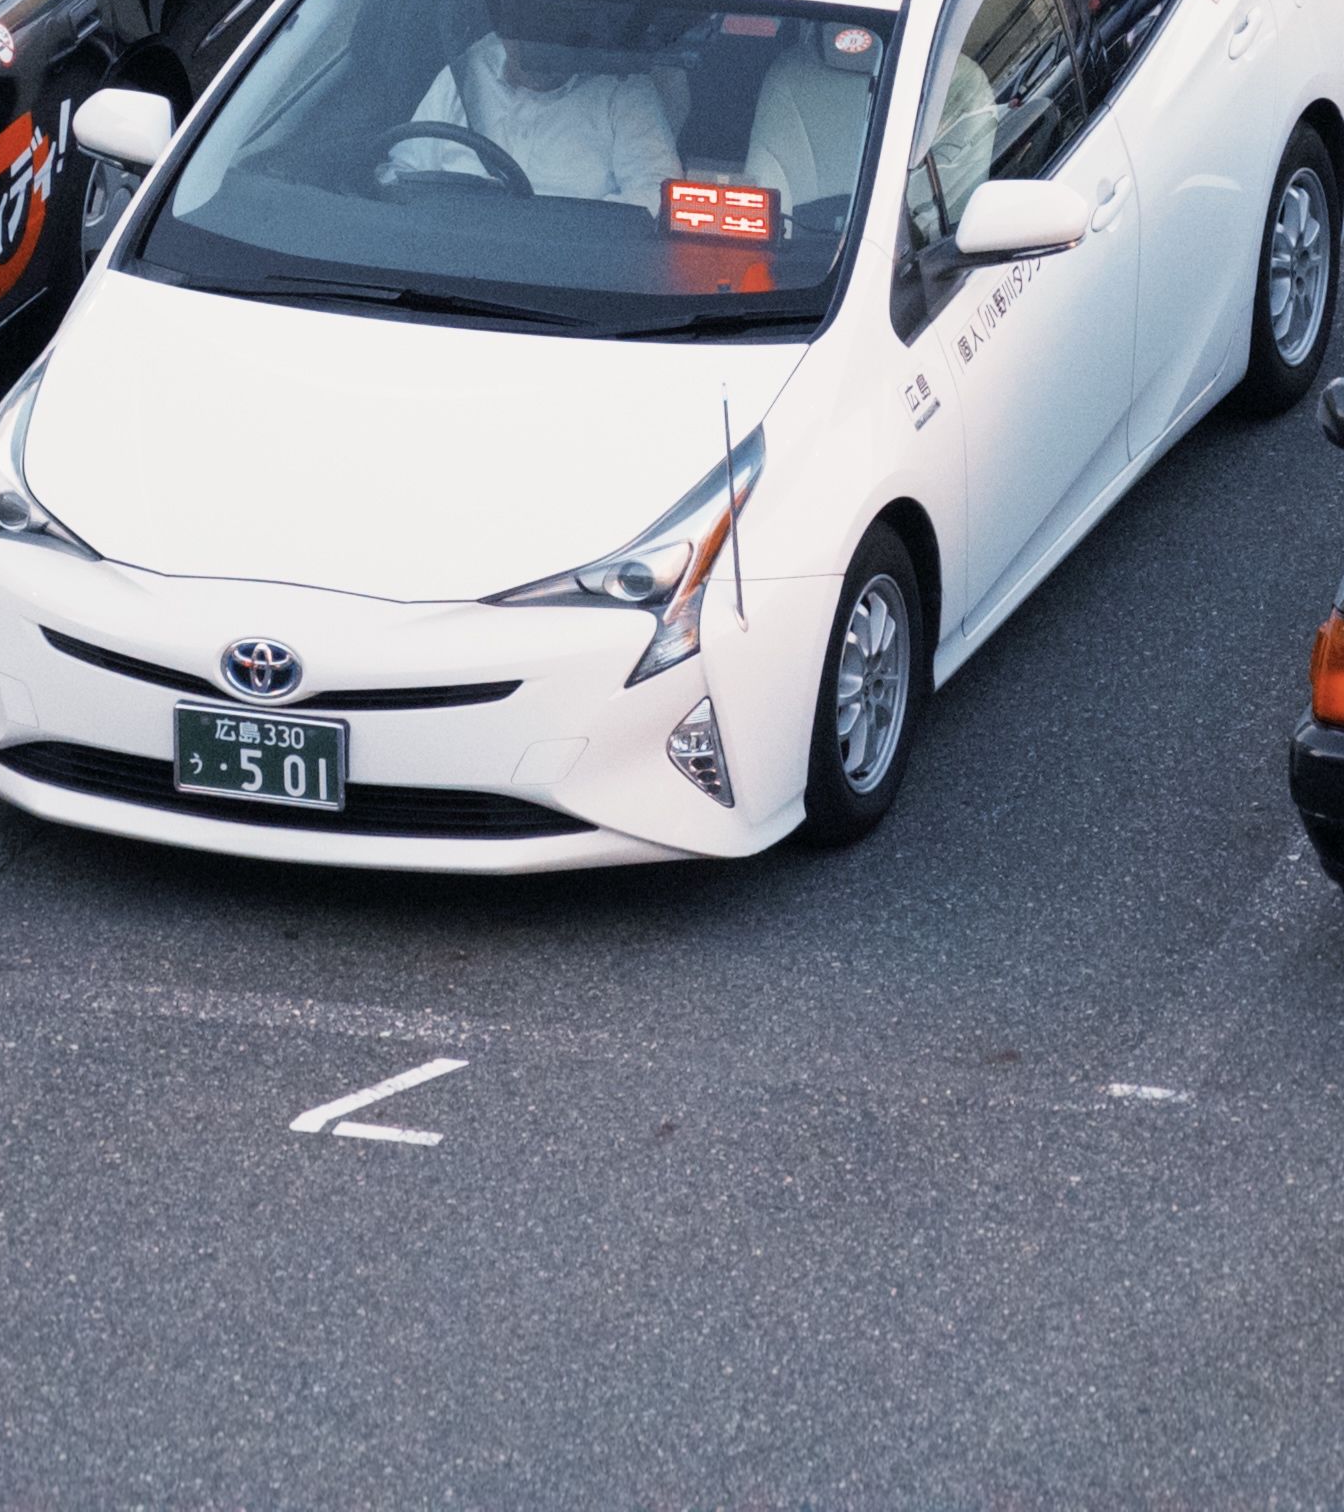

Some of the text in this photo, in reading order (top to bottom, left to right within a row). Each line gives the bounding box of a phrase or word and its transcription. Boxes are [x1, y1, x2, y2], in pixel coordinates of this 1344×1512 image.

[957, 325, 984, 364] 個人
[904, 373, 932, 413] 広島
[214, 718, 305, 750] 広島330
[188, 752, 204, 775] う
